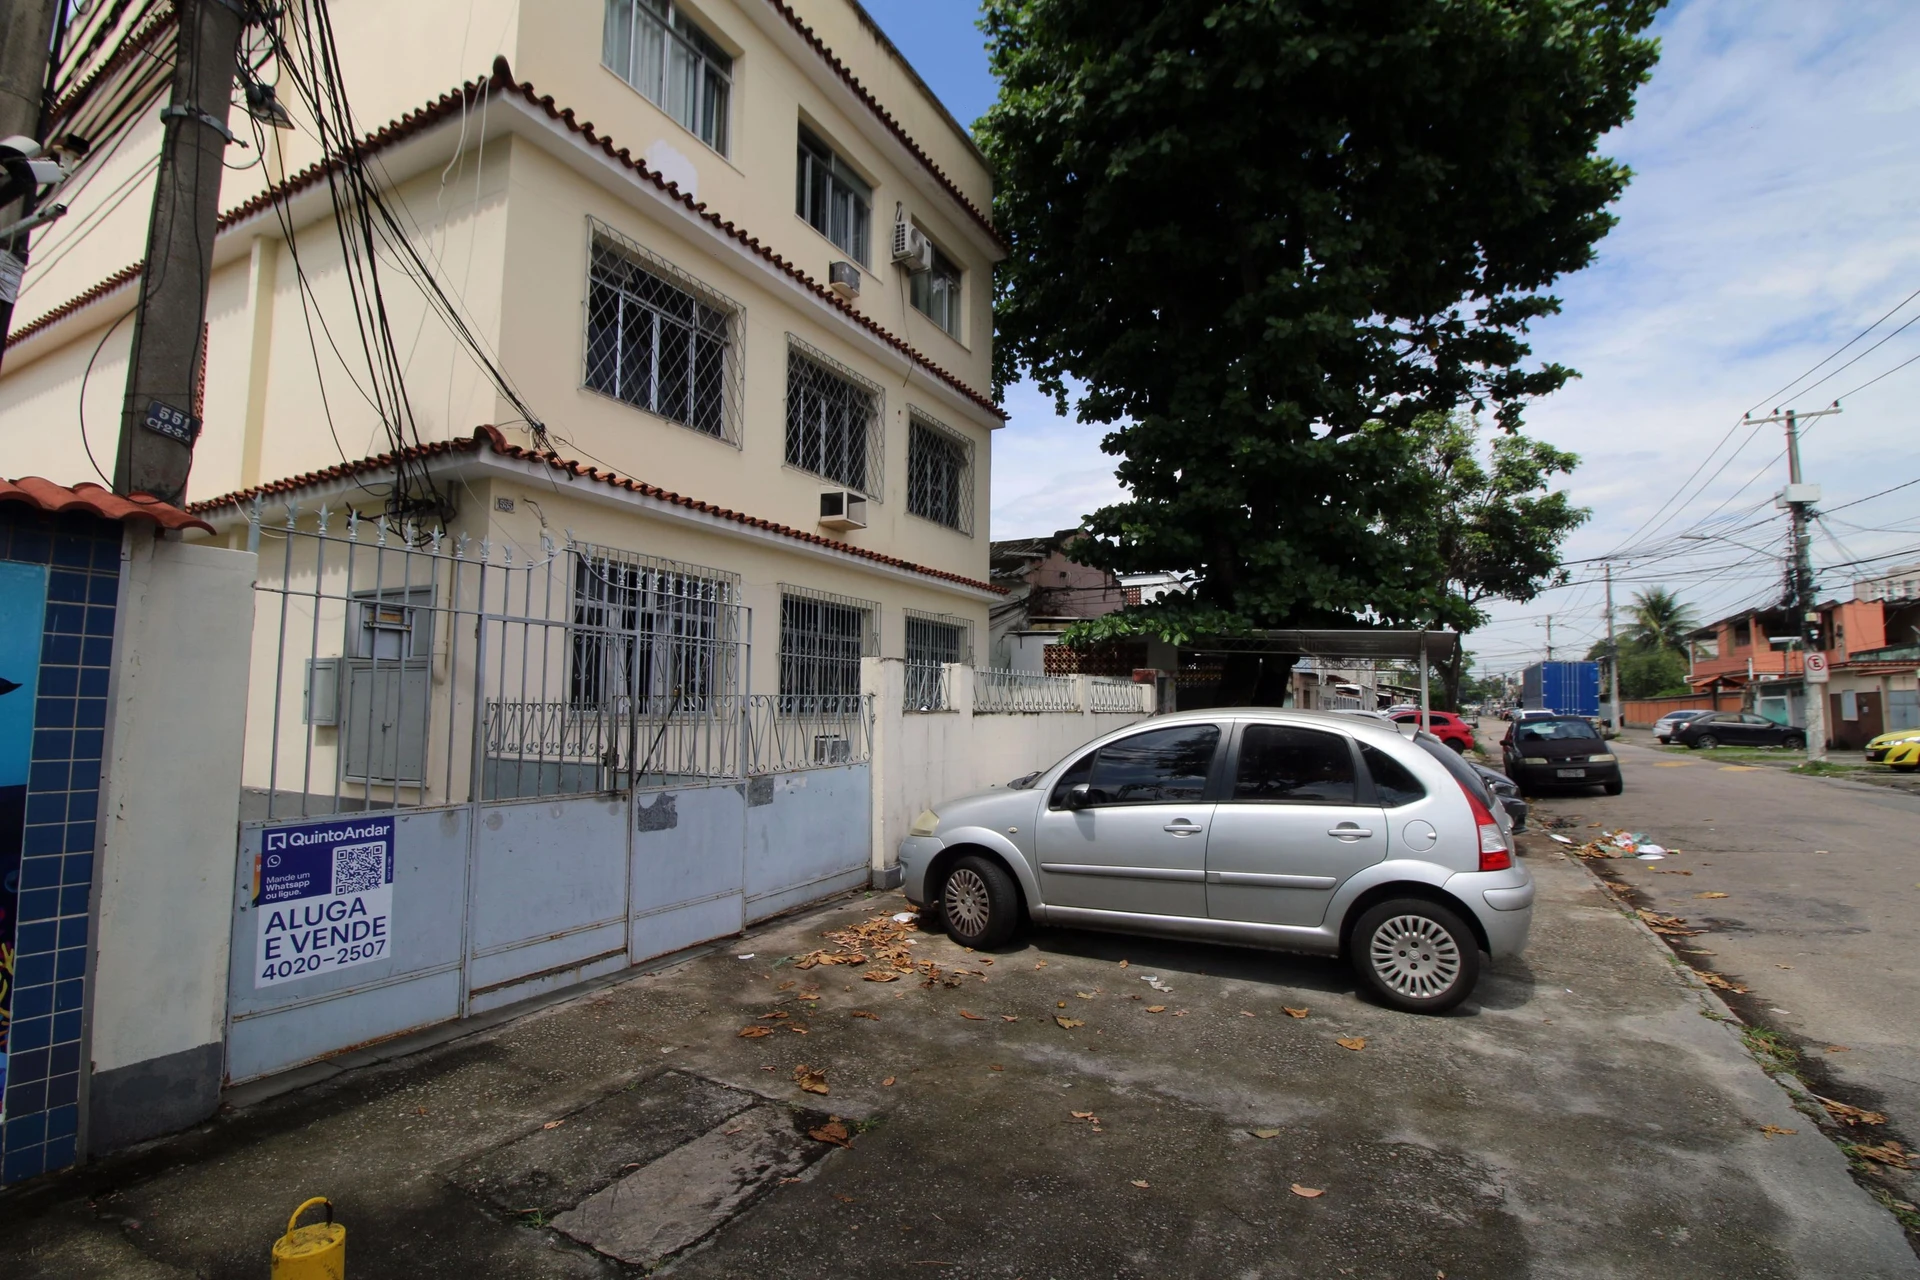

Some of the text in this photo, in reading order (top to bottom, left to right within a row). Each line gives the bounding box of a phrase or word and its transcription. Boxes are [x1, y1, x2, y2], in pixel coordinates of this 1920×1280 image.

[158, 406, 191, 430] 551
[289, 824, 391, 846] QuintoAndar
[265, 880, 310, 892] Whatsapp
[266, 872, 311, 884] Mande um
[278, 889, 302, 899] ligue.
[264, 896, 368, 935] ALUGA
[264, 915, 387, 960] E VENDE
[261, 939, 387, 980] 4020-2507
